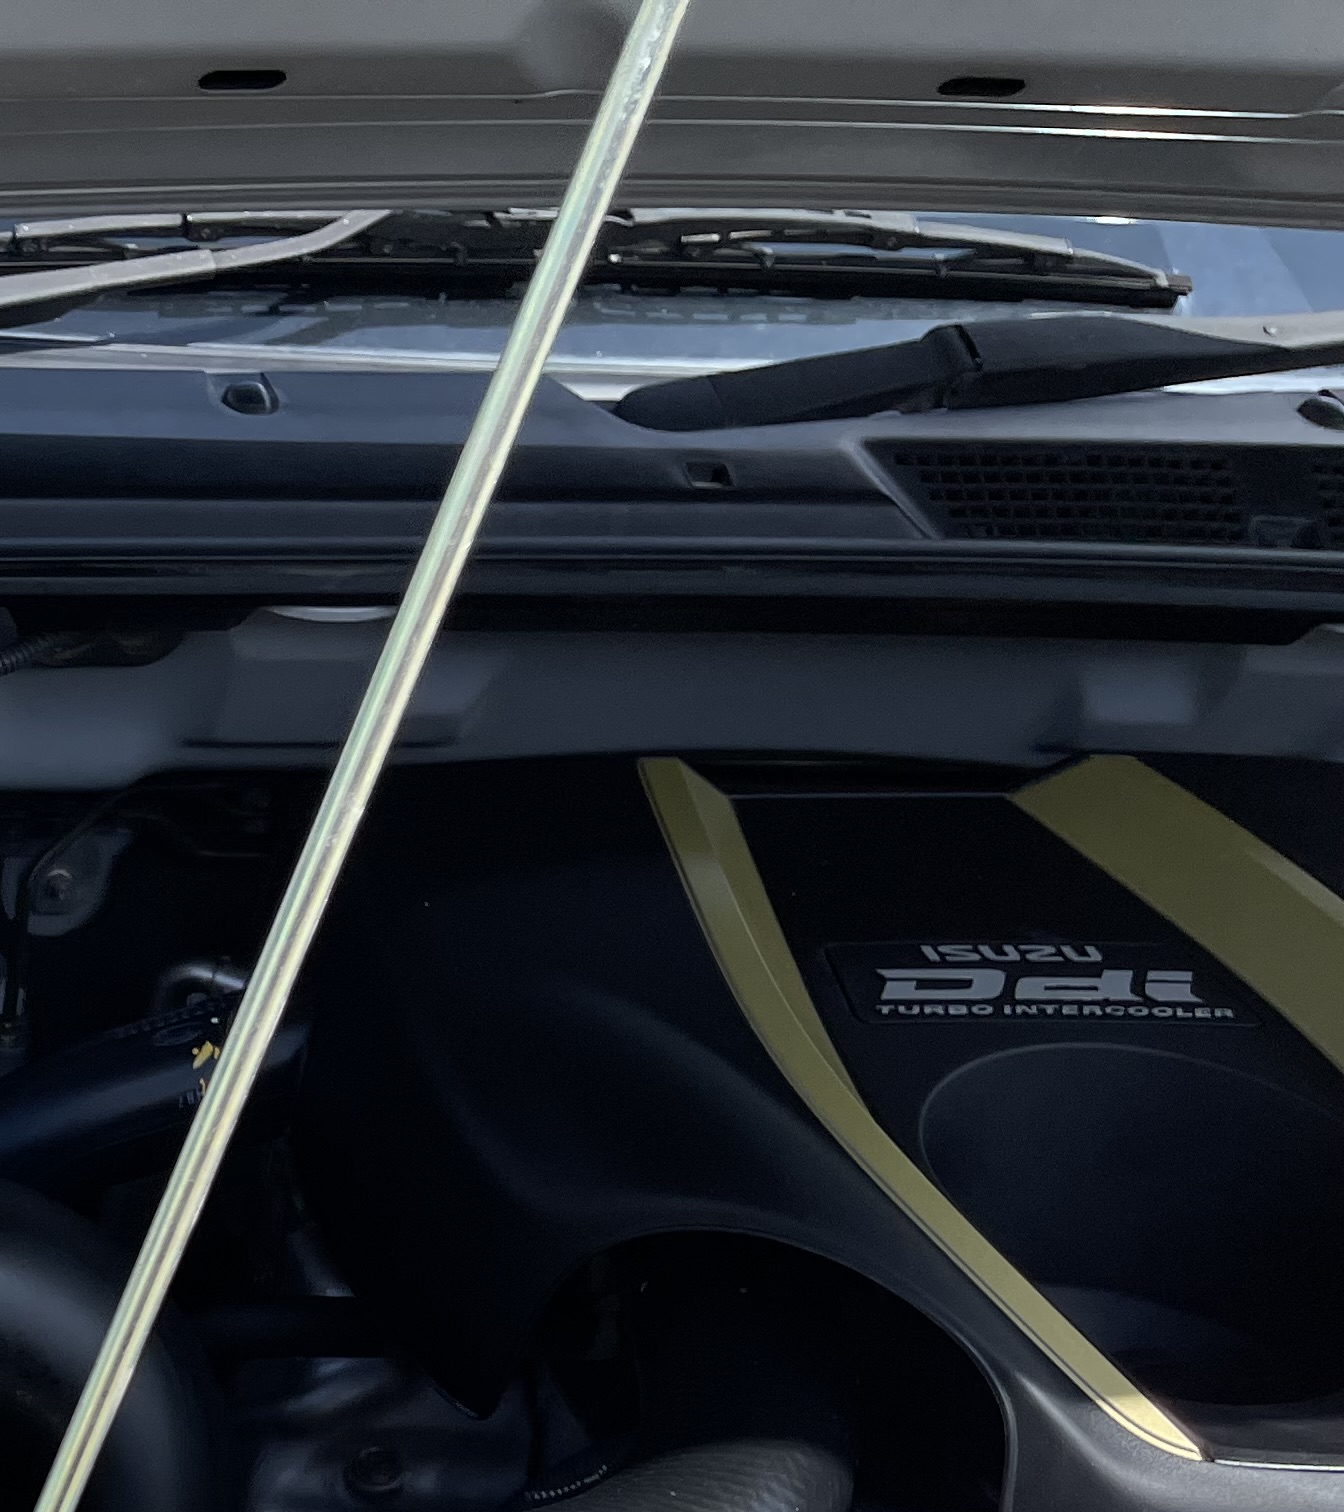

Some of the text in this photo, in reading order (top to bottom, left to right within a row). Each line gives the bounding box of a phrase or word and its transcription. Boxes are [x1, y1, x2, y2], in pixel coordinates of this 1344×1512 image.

[919, 944, 1103, 963] ISUZU
[876, 1004, 1235, 1020] TURBO INTERCOOLER
